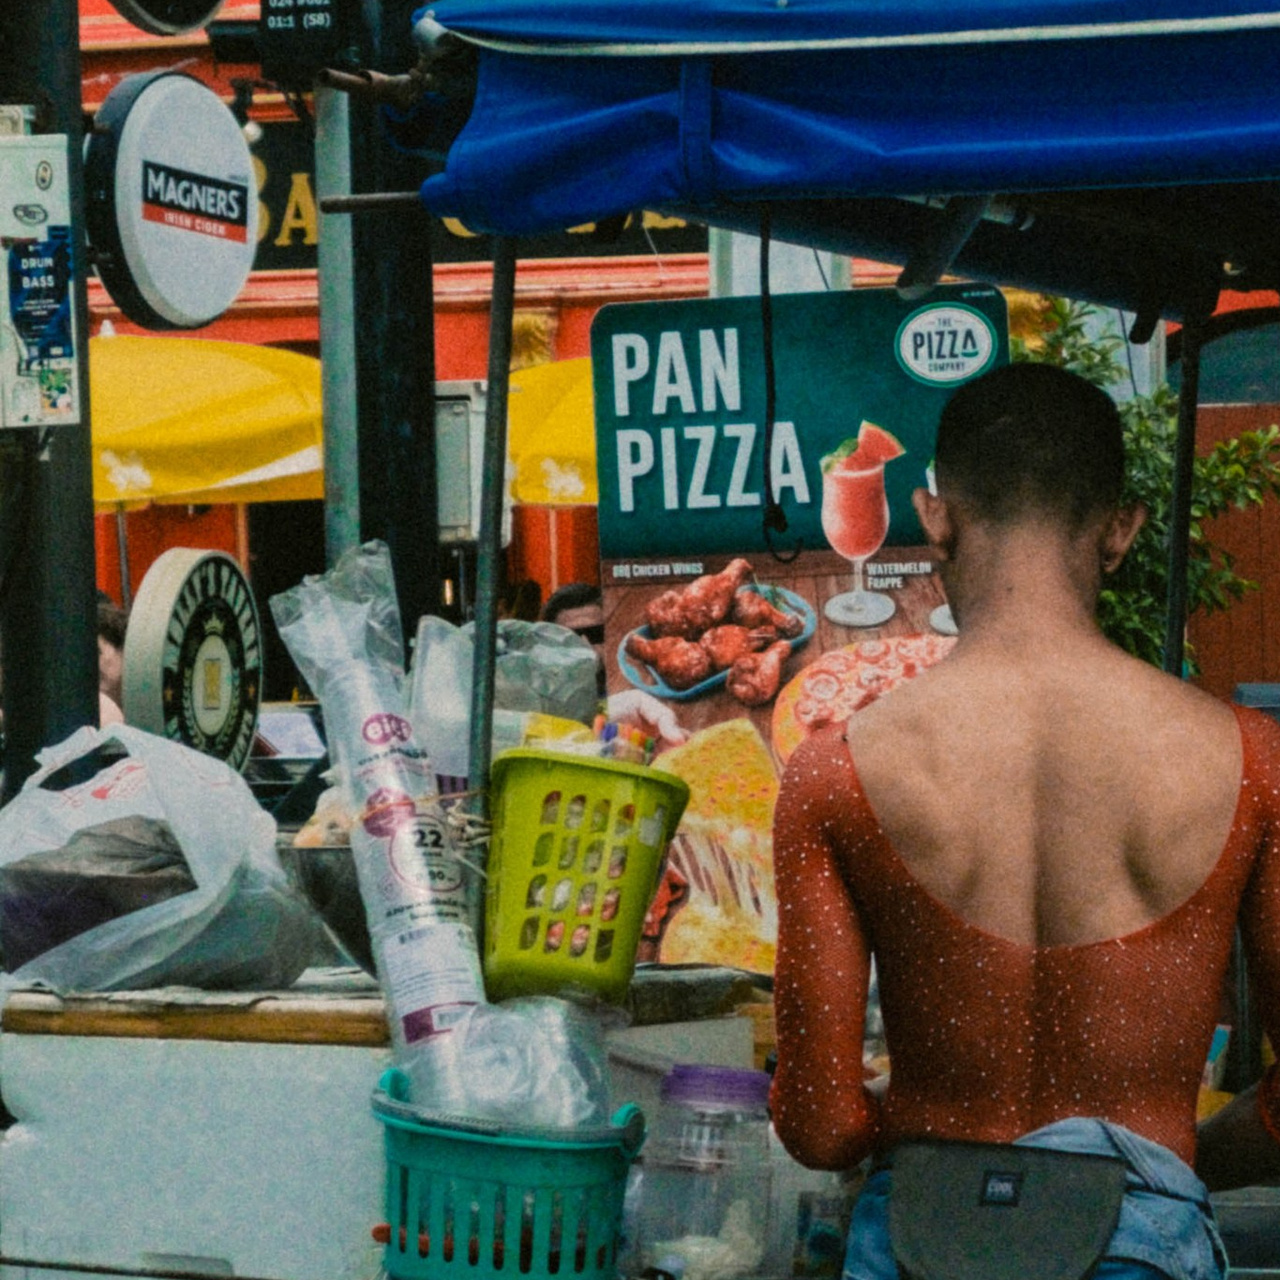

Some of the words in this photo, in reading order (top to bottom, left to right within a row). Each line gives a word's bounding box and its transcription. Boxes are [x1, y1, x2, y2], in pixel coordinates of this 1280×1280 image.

[147, 167, 240, 219] MAGNERS
[21, 258, 54, 269] DRUM
[21, 276, 55, 288] BASS
[912, 328, 979, 360] PIZZA
[610, 327, 742, 418] PAN
[616, 420, 812, 513] PIZZA
[632, 563, 670, 578] CHICKEN
[671, 562, 704, 576] WINGS
[866, 561, 933, 576] WATERMELON
[867, 576, 903, 589] FRAPPE
[412, 829, 445, 848] 22
